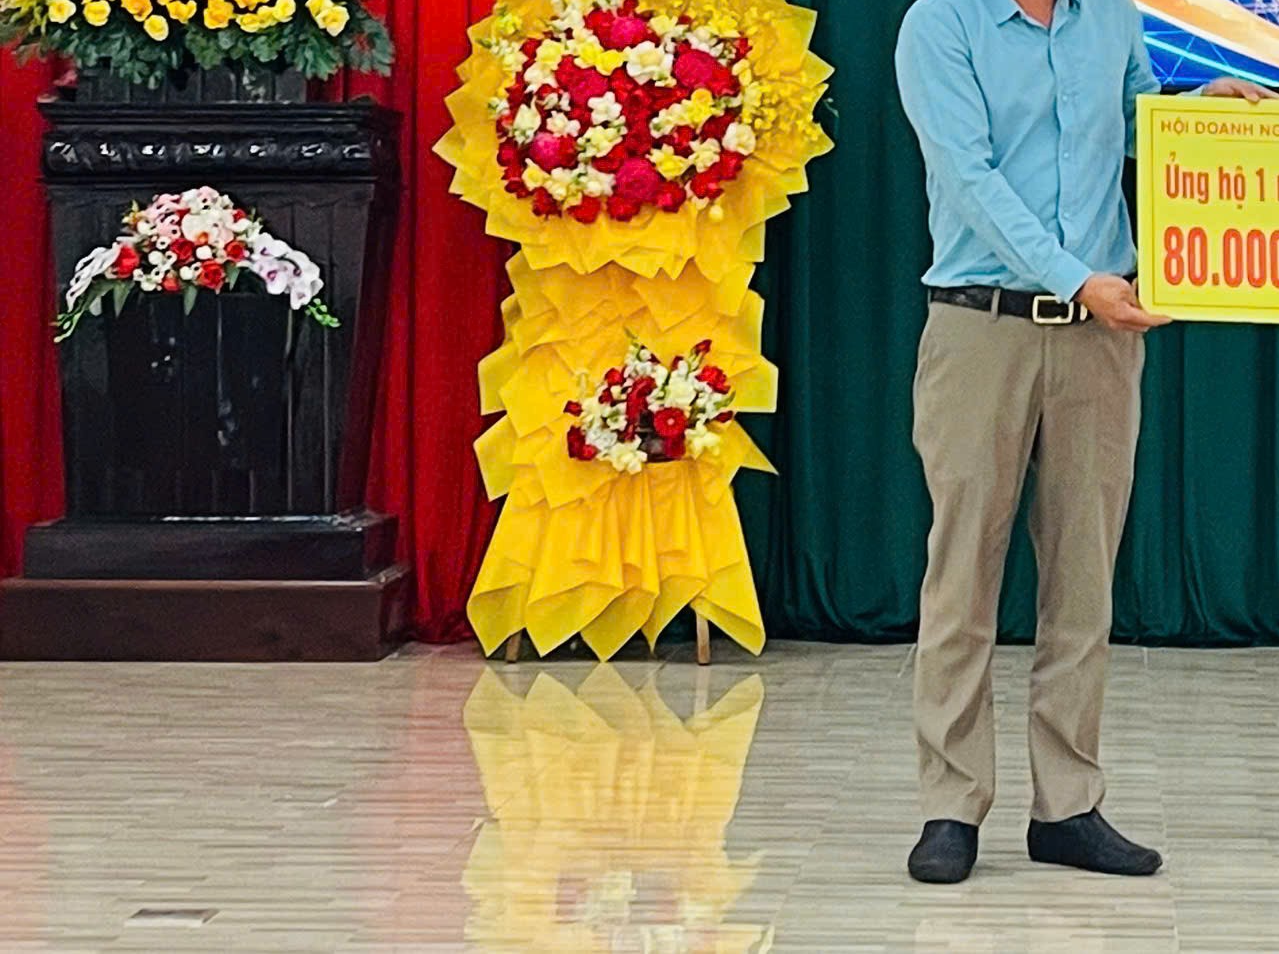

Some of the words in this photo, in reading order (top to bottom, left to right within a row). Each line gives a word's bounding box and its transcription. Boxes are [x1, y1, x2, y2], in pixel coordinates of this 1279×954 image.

[1161, 117, 1189, 136] HỘI
[1195, 121, 1254, 137] DOANH
[1166, 151, 1209, 204] Ủng
[1218, 165, 1246, 209] hộ
[1256, 167, 1265, 202] 1
